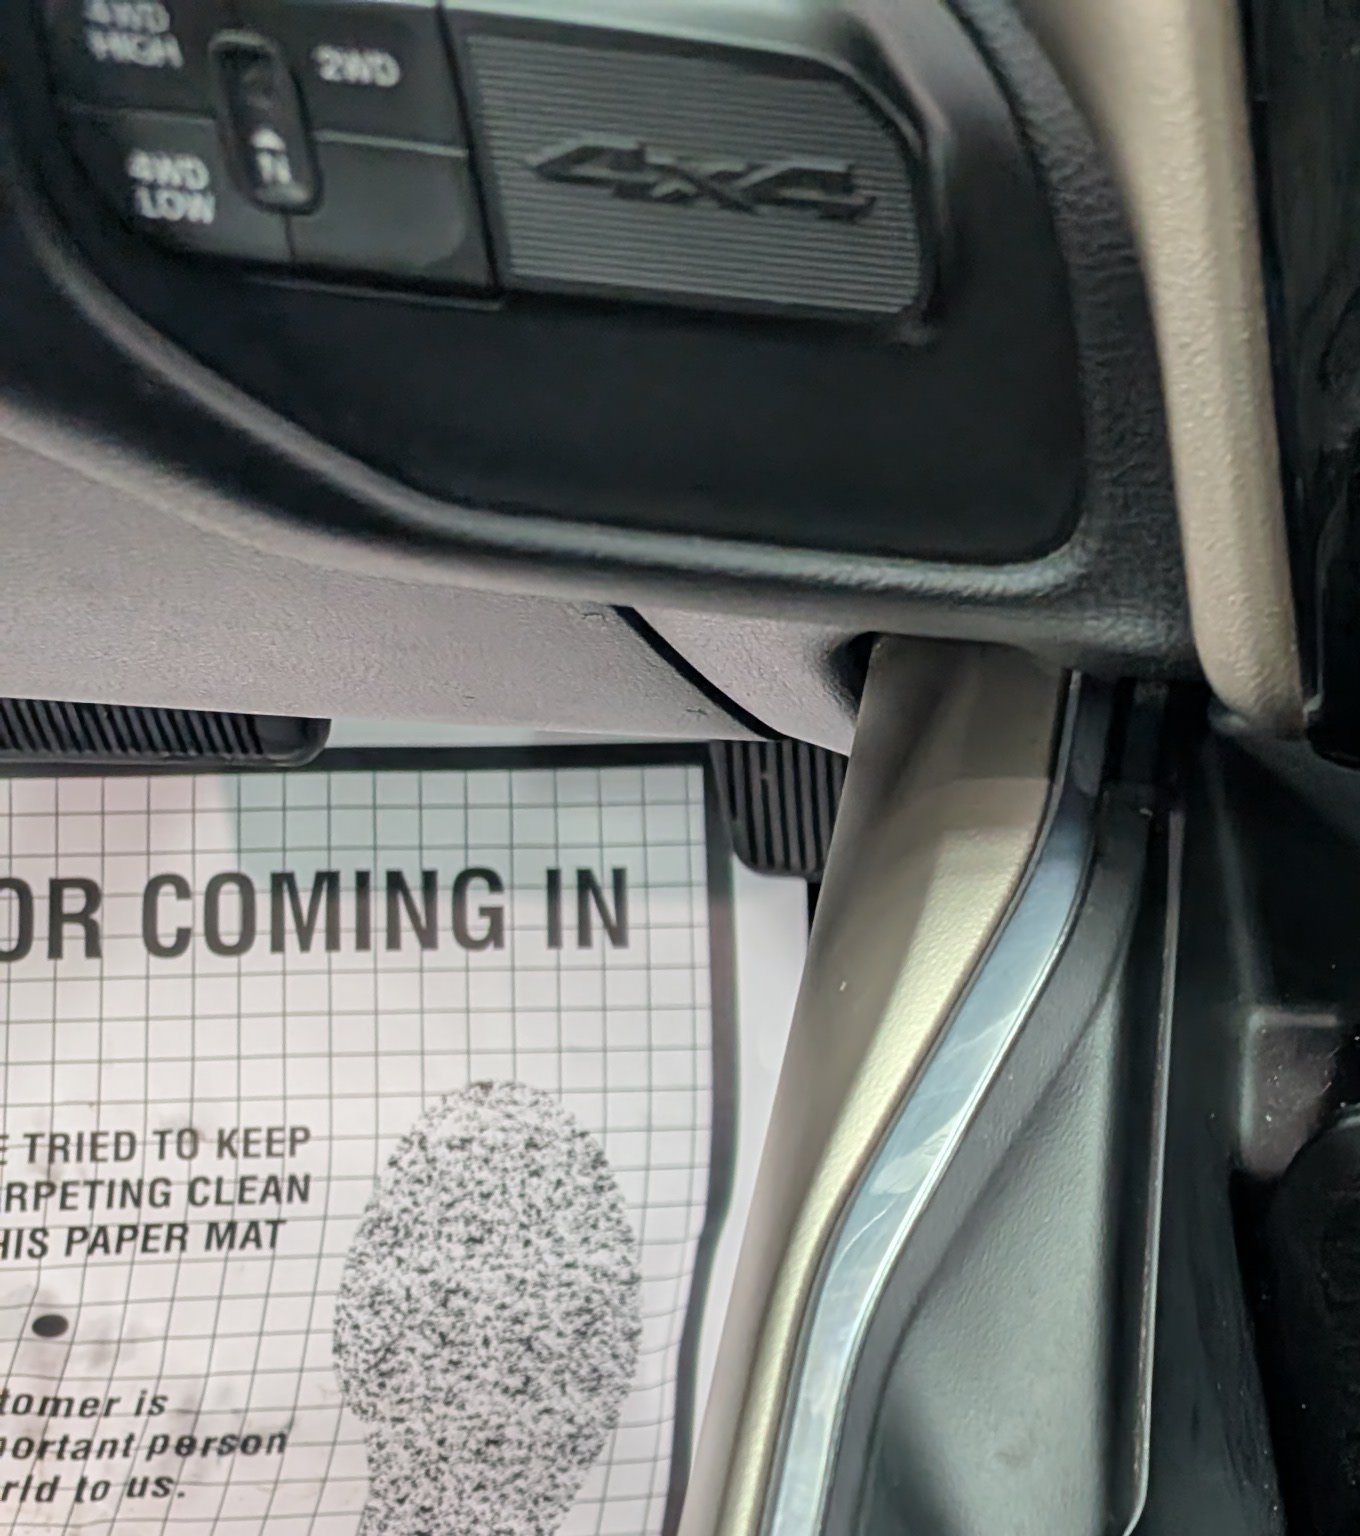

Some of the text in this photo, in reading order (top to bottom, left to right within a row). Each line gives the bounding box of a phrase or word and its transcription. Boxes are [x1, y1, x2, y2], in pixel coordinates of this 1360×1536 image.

[312, 45, 400, 87] 2WD
[126, 150, 210, 190] 4WD
[134, 184, 216, 225] LOW
[142, 867, 504, 959] COMING
[546, 867, 628, 950] IN
[23, 1130, 137, 1164] TRIED
[152, 1128, 199, 1161] TO
[216, 1126, 311, 1159] KEEP
[0, 1173, 311, 1213] RPETING CLEAN
[64, 1223, 189, 1257] PAPER
[204, 1219, 287, 1250] MAT
[135, 1389, 169, 1417] is
[145, 1430, 289, 1461] person
[1, 1474, 186, 1504] rld to us.
